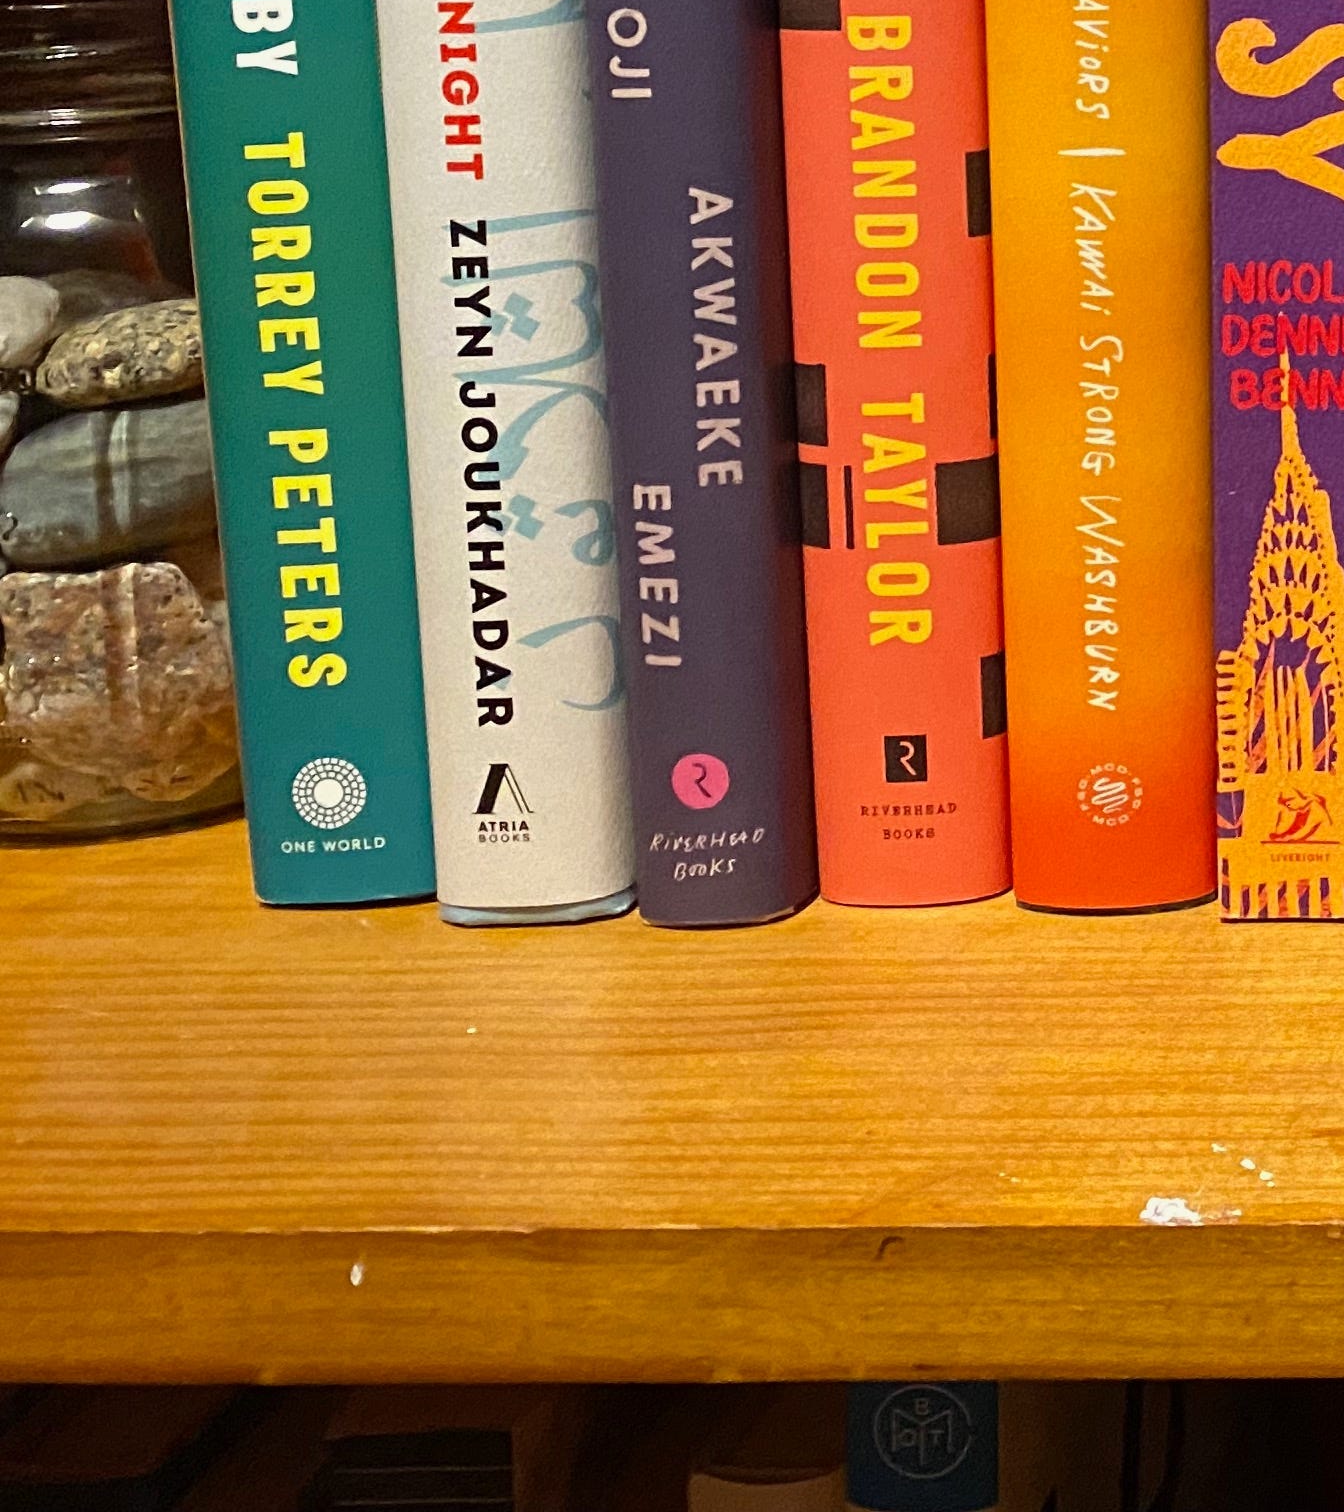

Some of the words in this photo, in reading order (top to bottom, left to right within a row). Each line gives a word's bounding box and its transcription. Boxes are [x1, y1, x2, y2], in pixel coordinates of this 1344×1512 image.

[438, 1, 484, 180] NIGHT
[606, 7, 653, 99] OJI
[244, 132, 324, 395] TORREY
[846, 15, 923, 349] BRANDON
[449, 219, 493, 357] ZEYN
[688, 187, 744, 488] AKWAEKE
[1080, 335, 1124, 476] STRONG
[268, 428, 347, 688] PETERS
[458, 381, 514, 728] JOUKHADAR
[633, 484, 683, 667] EMEZI
[860, 392, 934, 646] TAYLOR
[1074, 494, 1125, 711] WASHBURN
[281, 840, 314, 854] ONE
[322, 835, 386, 853] WORLD
[478, 821, 530, 832] ATRIA
[860, 801, 957, 818] RIVERHEAD
[883, 826, 935, 841] BOOKS
